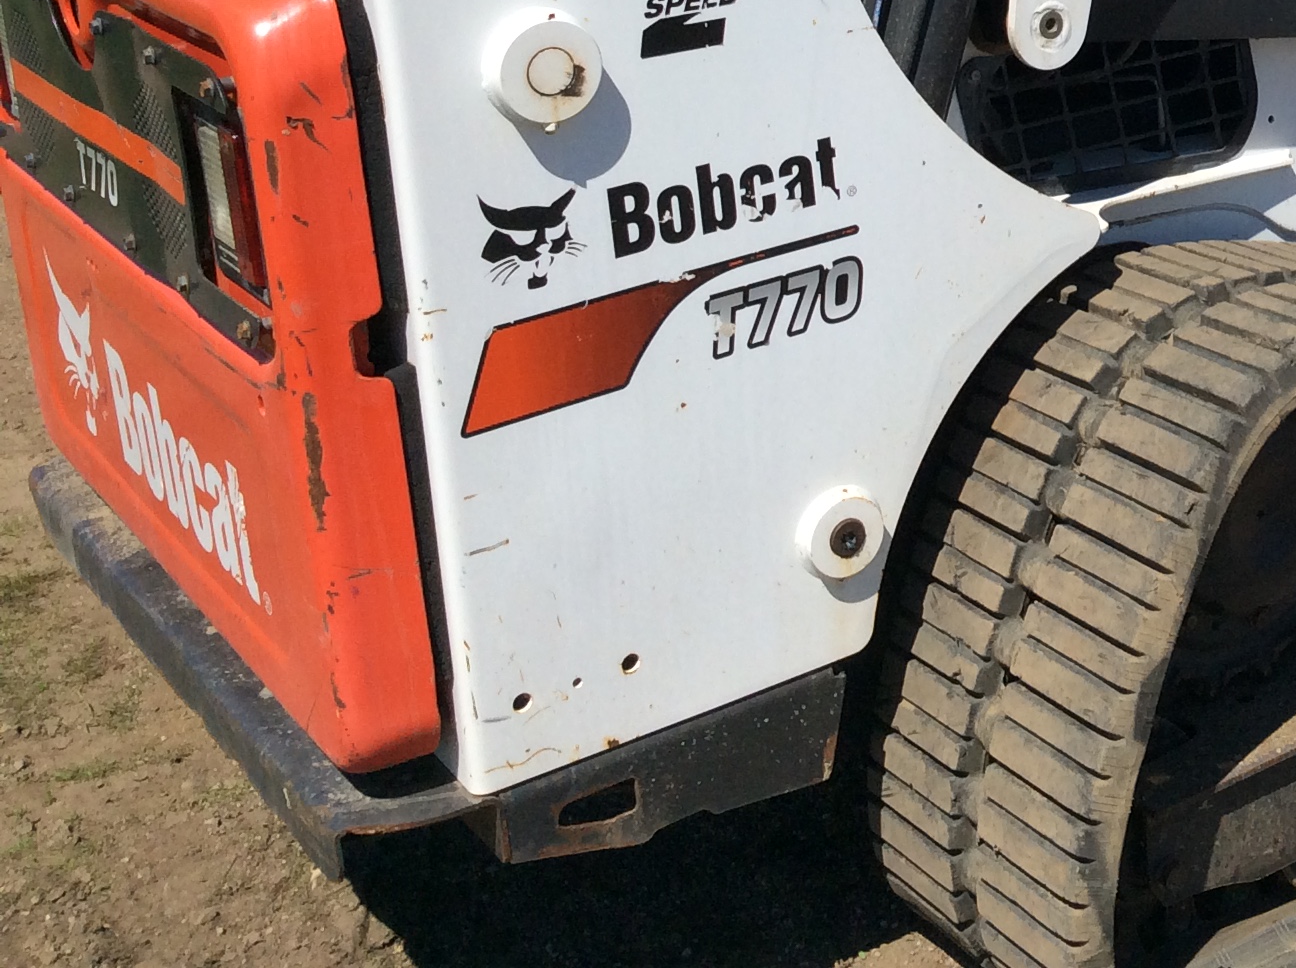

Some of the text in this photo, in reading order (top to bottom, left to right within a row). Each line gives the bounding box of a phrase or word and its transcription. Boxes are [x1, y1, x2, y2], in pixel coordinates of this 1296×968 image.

[73, 136, 118, 207] T770
[607, 137, 841, 259] Bobcat
[704, 256, 864, 360] T770
[103, 338, 262, 606] Bobcat
